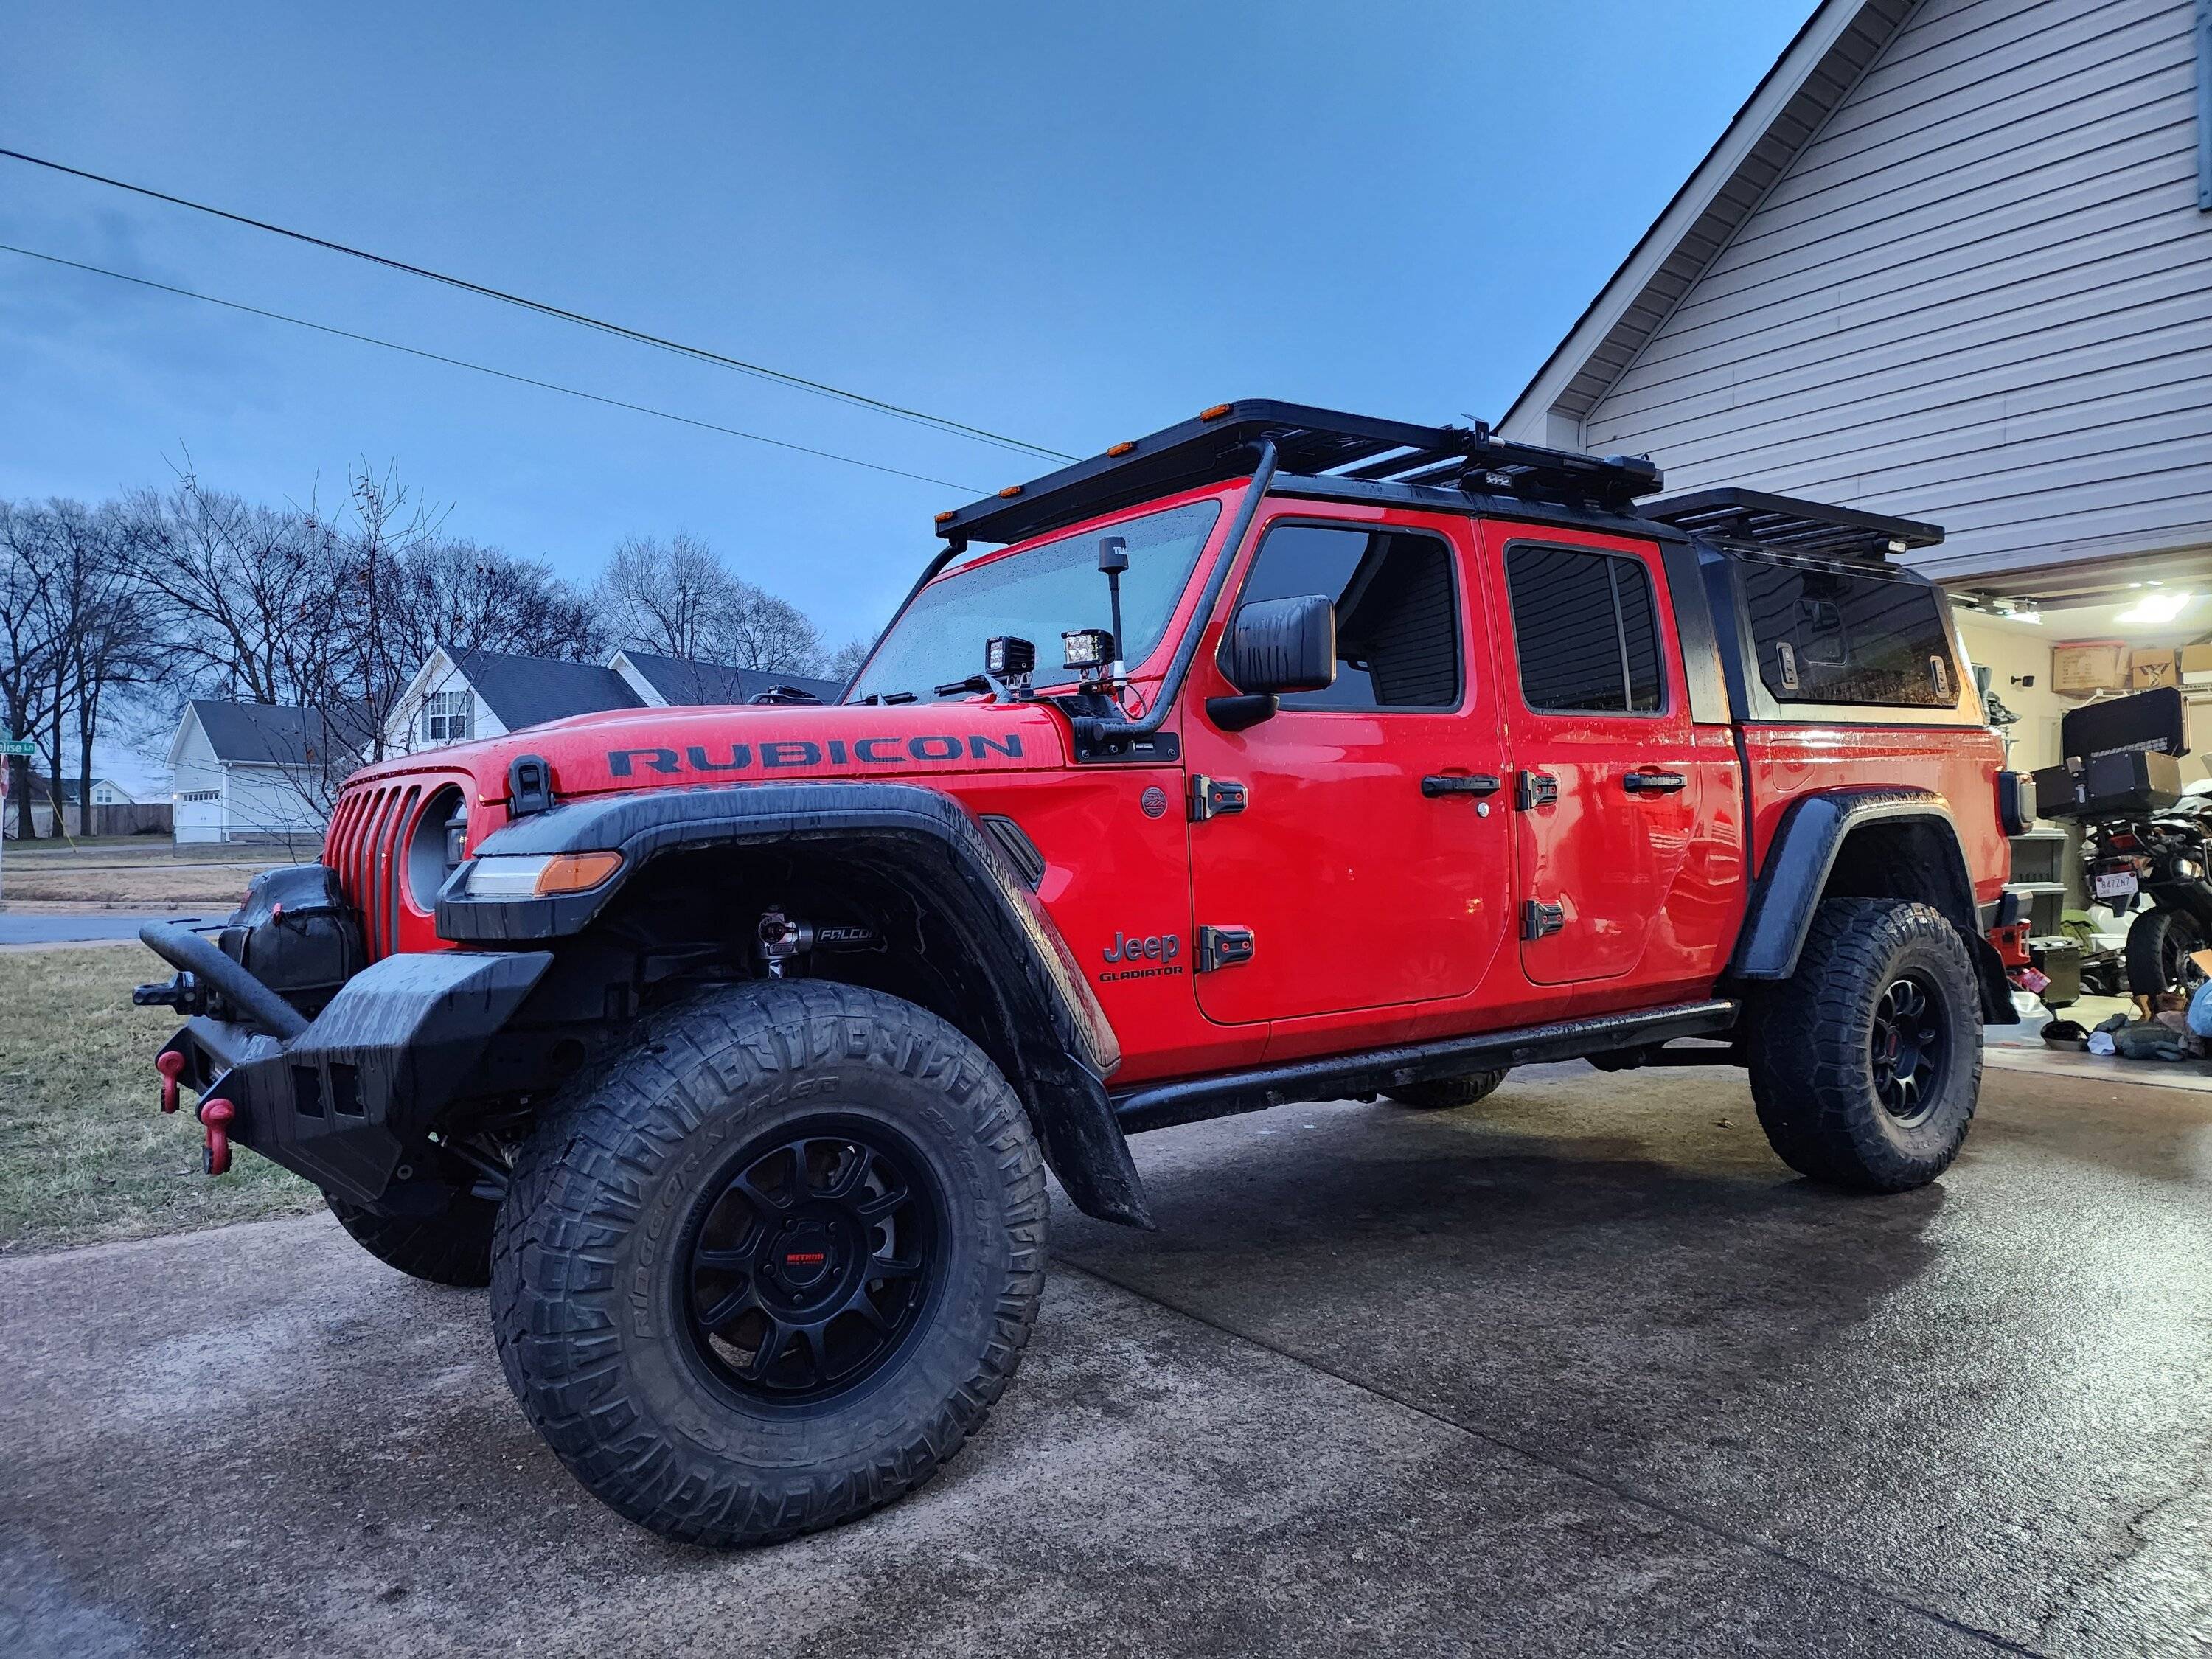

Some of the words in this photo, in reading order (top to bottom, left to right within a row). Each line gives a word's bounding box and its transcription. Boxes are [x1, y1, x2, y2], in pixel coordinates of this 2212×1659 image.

[24, 743, 34, 751] Ln
[607, 734, 1024, 777] RUBICON
[1103, 931, 1180, 963] Jeep
[1099, 966, 1184, 982] GLADIATOR
